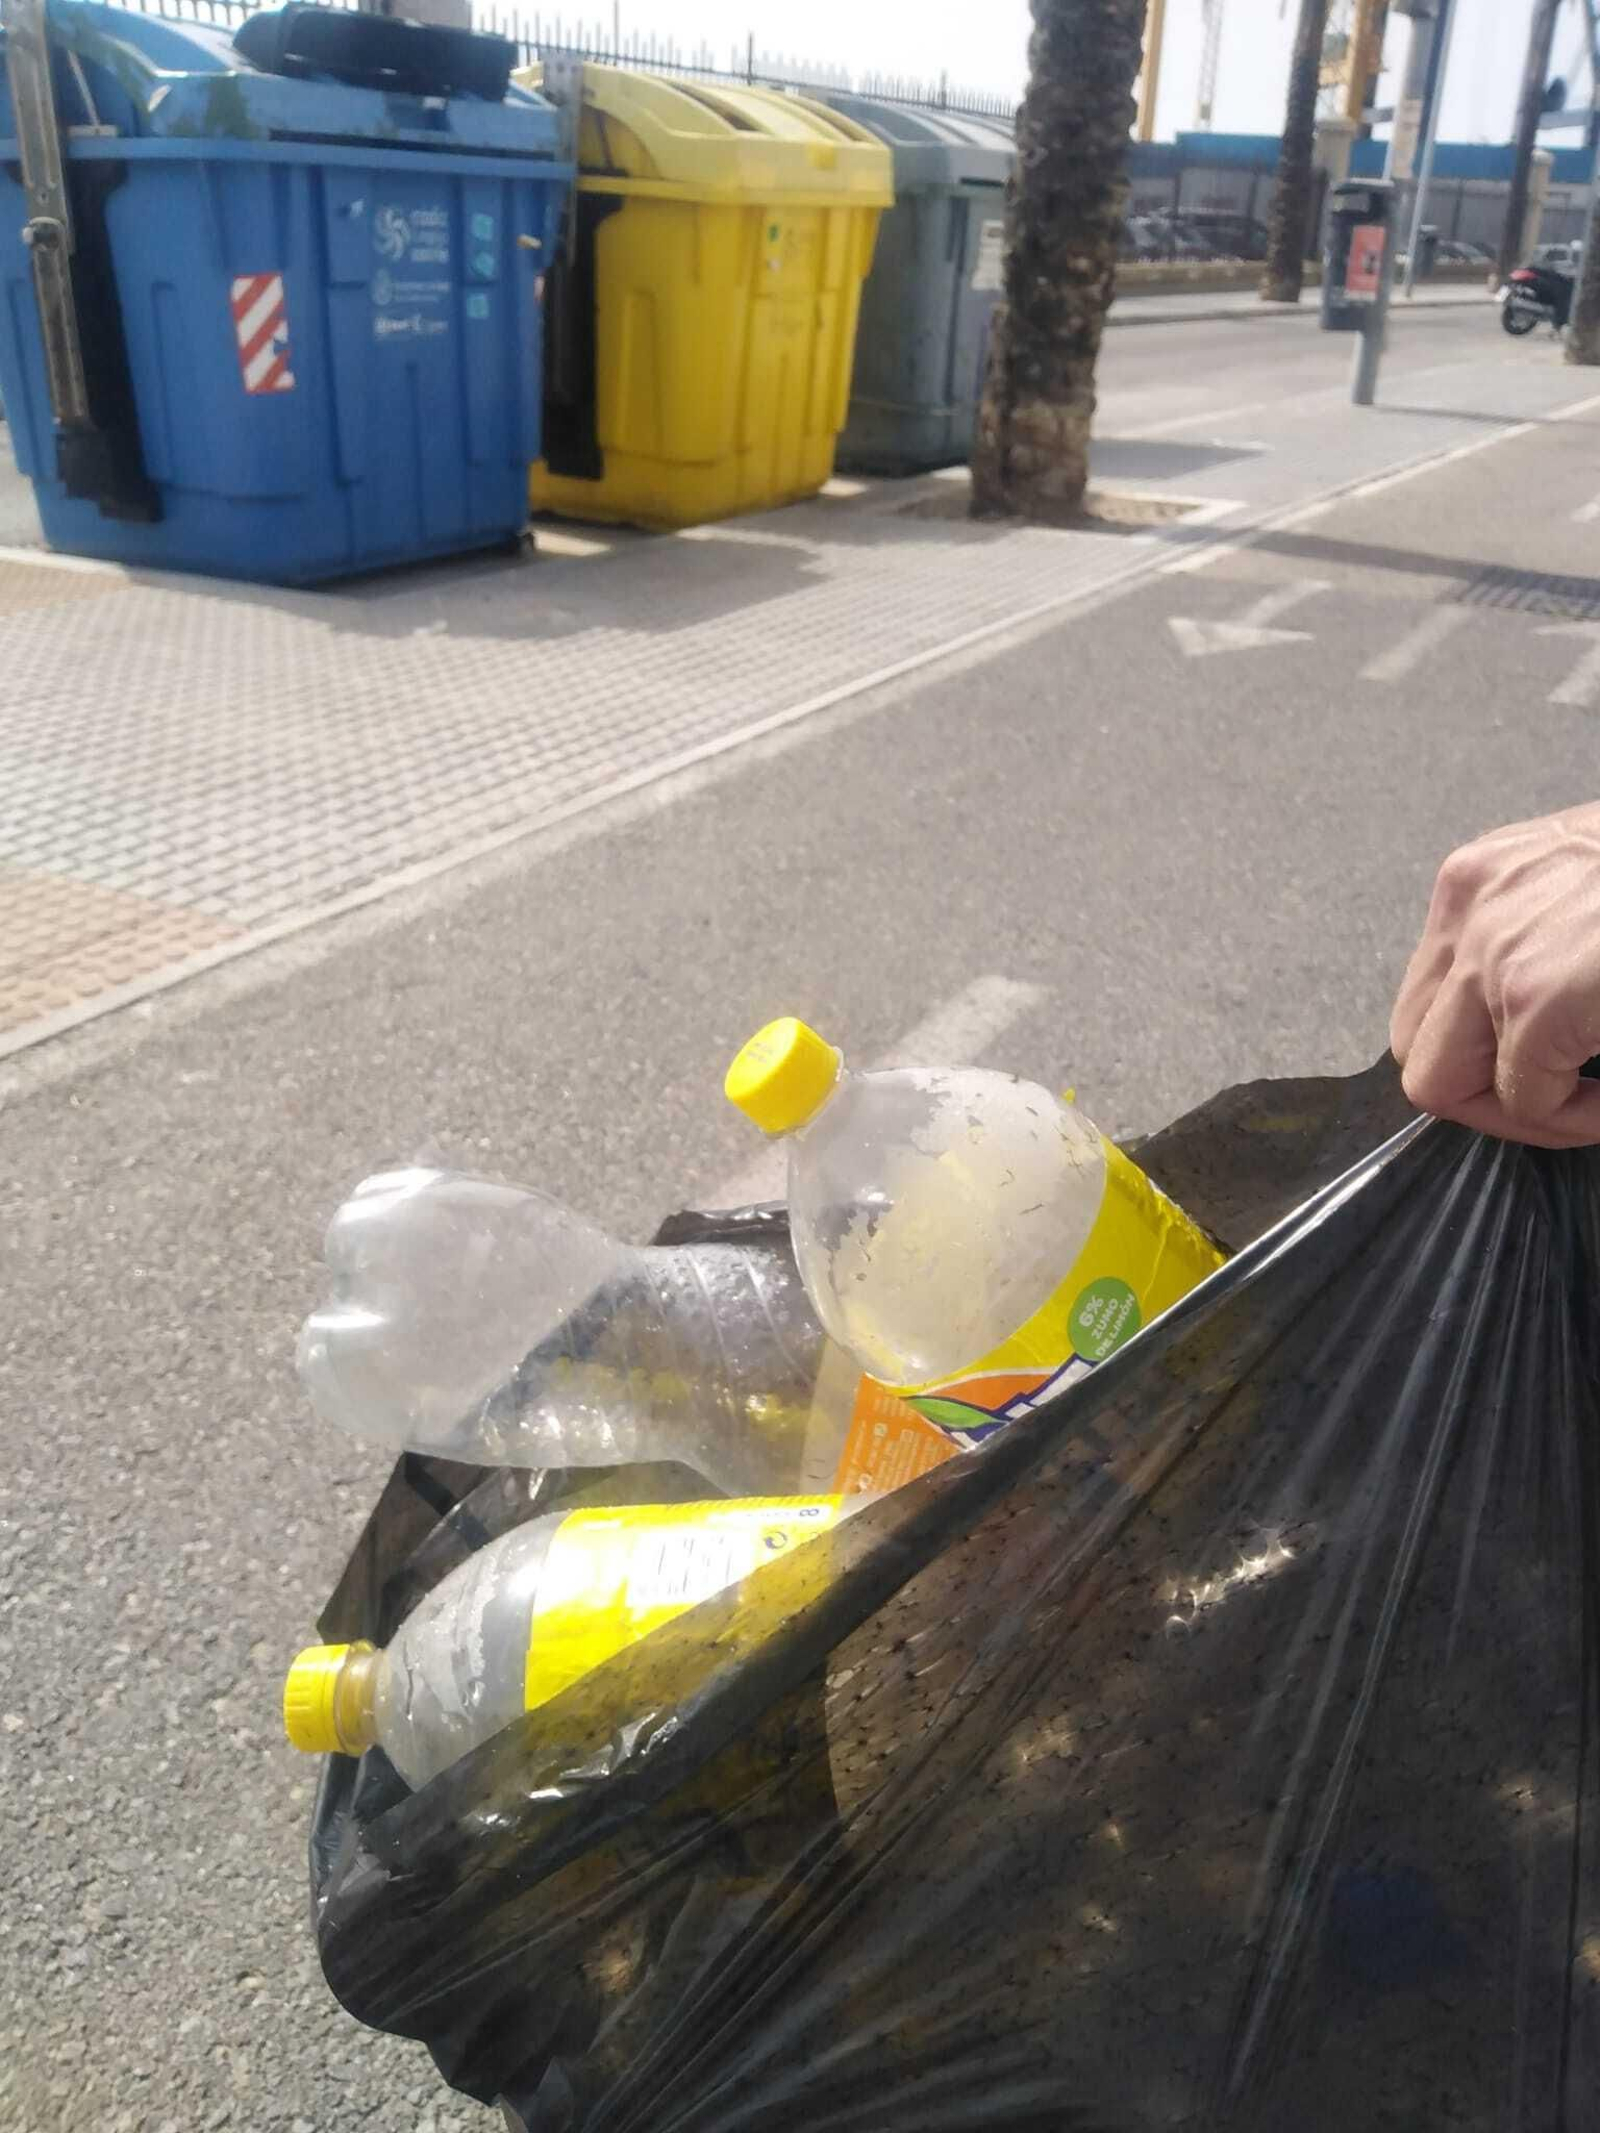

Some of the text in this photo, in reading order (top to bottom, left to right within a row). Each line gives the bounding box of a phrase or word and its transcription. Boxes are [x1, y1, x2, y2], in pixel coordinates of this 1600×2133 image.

[1079, 1295, 1104, 1327] 6%
[1091, 1298, 1118, 1340] ZUMO
[1095, 1293, 1135, 1356] DE LIMÓN
